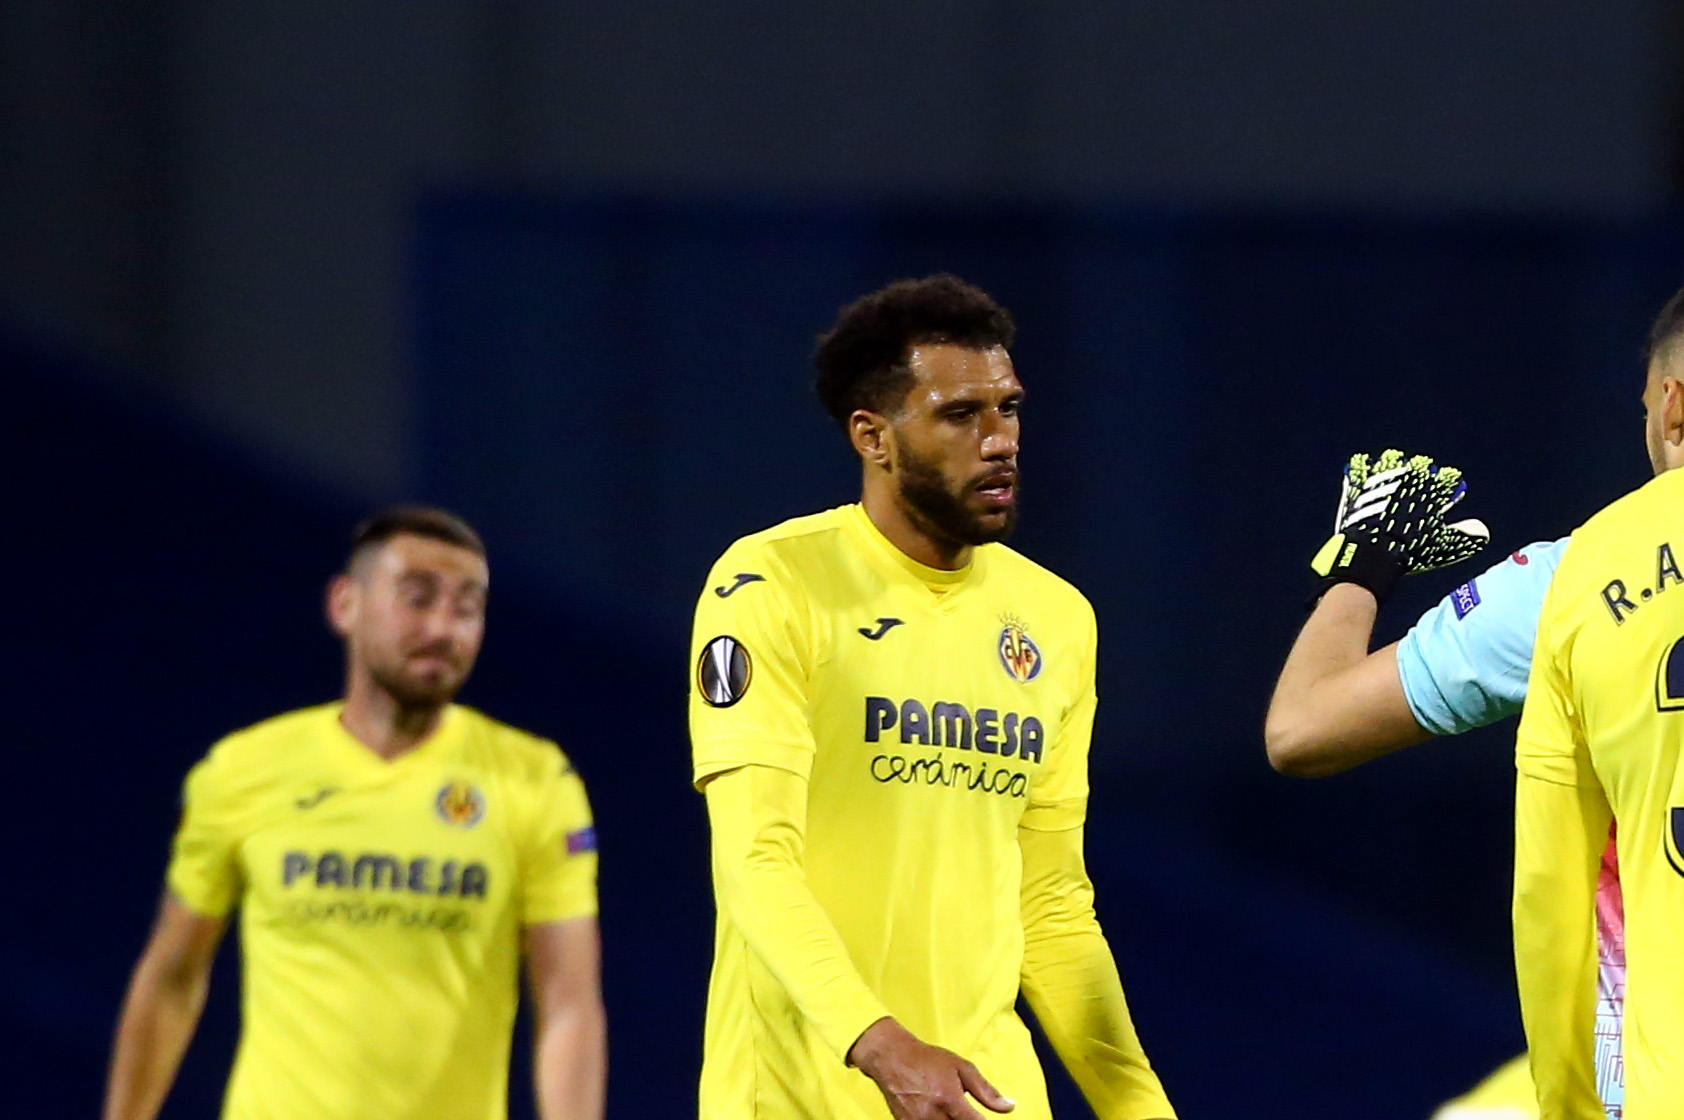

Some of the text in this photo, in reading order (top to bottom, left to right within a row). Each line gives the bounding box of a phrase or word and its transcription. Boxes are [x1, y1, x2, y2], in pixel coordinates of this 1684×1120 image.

[865, 696, 1044, 764] PAMESA
[871, 753, 1027, 797] cerámica
[282, 851, 487, 899] PAMESA
